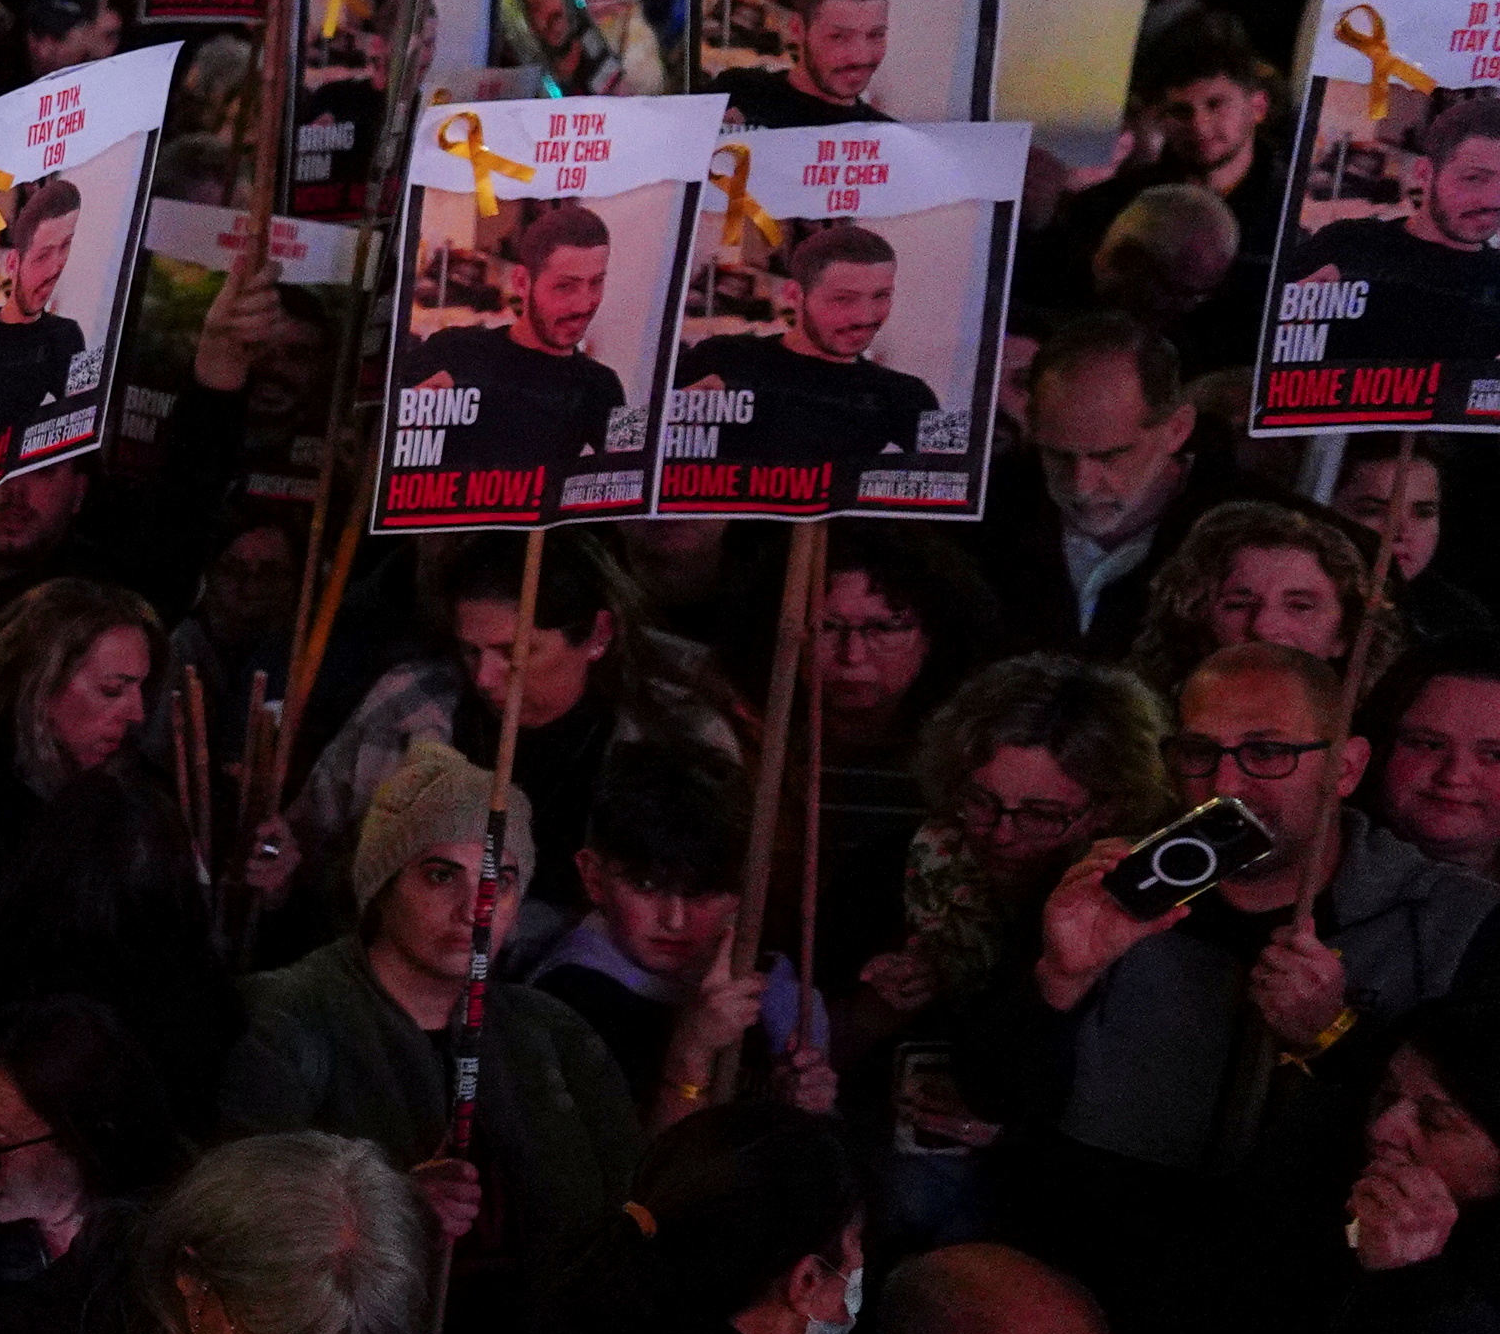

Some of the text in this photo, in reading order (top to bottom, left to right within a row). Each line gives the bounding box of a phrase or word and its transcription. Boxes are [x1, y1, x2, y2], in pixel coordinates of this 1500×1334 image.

[28, 109, 86, 147] ITAY CHEN
[535, 140, 610, 162] ITAY CHEN
[557, 166, 586, 191] (19)
[803, 164, 888, 186] ITAY CHEN
[827, 189, 860, 212] (19)
[1279, 280, 1369, 320] BRING
[1272, 324, 1328, 363] HIM
[398, 388, 480, 426] BRING
[393, 430, 446, 467] HIM
